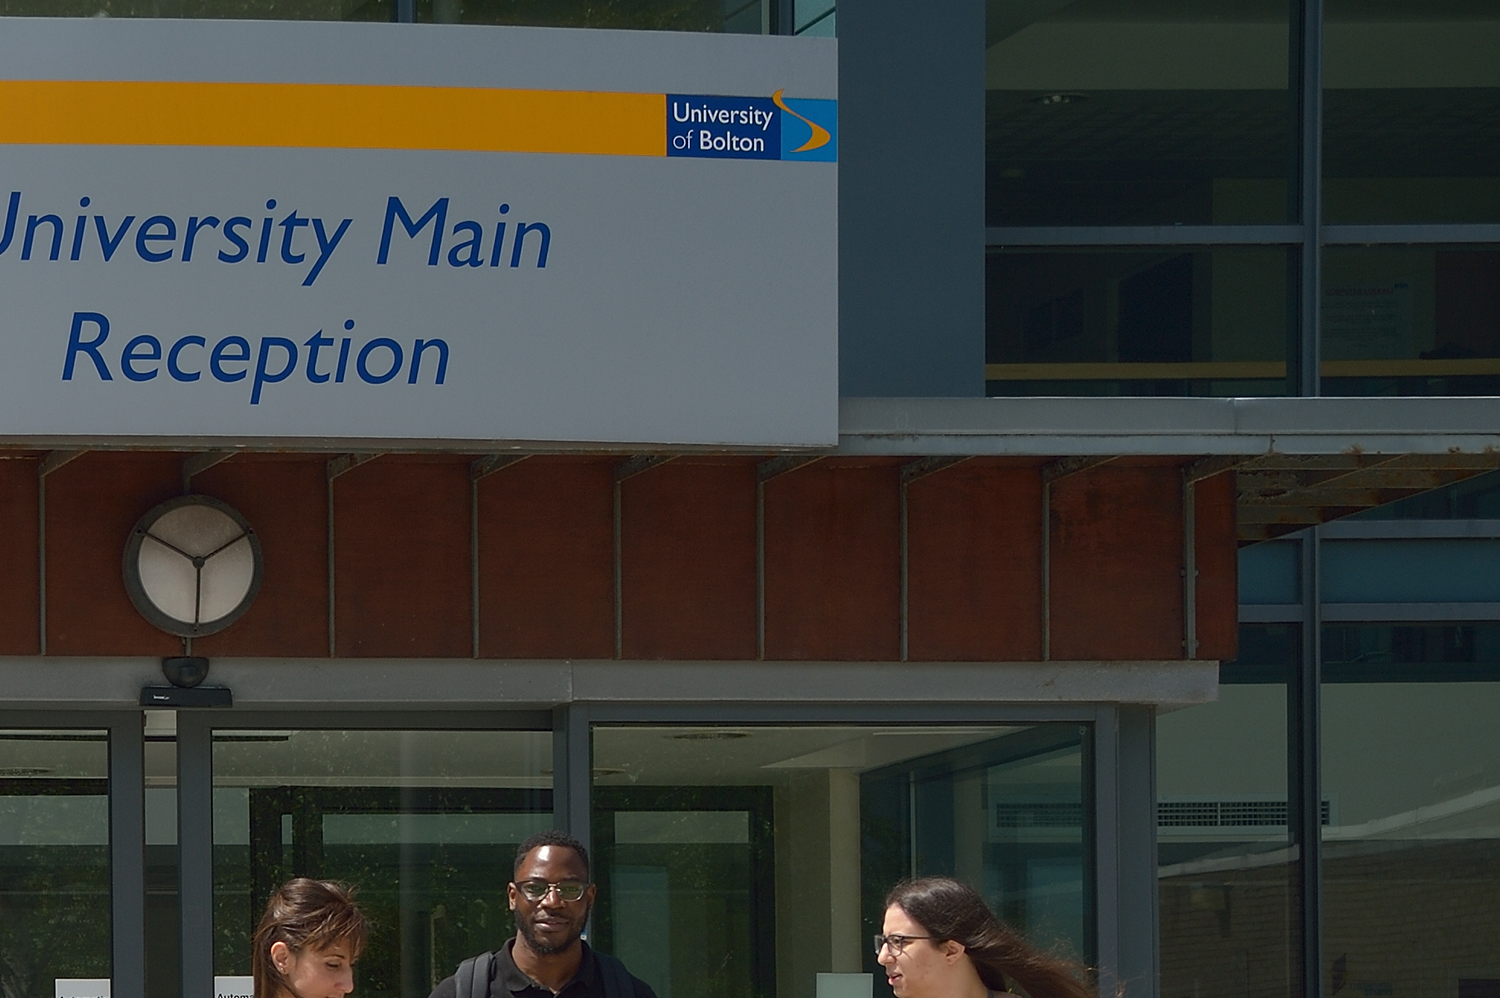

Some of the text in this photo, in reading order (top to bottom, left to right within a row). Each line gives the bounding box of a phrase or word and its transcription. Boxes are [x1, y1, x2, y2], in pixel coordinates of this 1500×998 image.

[672, 129, 764, 151] of Bolton
[673, 102, 773, 131] University
[376, 197, 552, 270] Main
[62, 312, 450, 406] Reception
